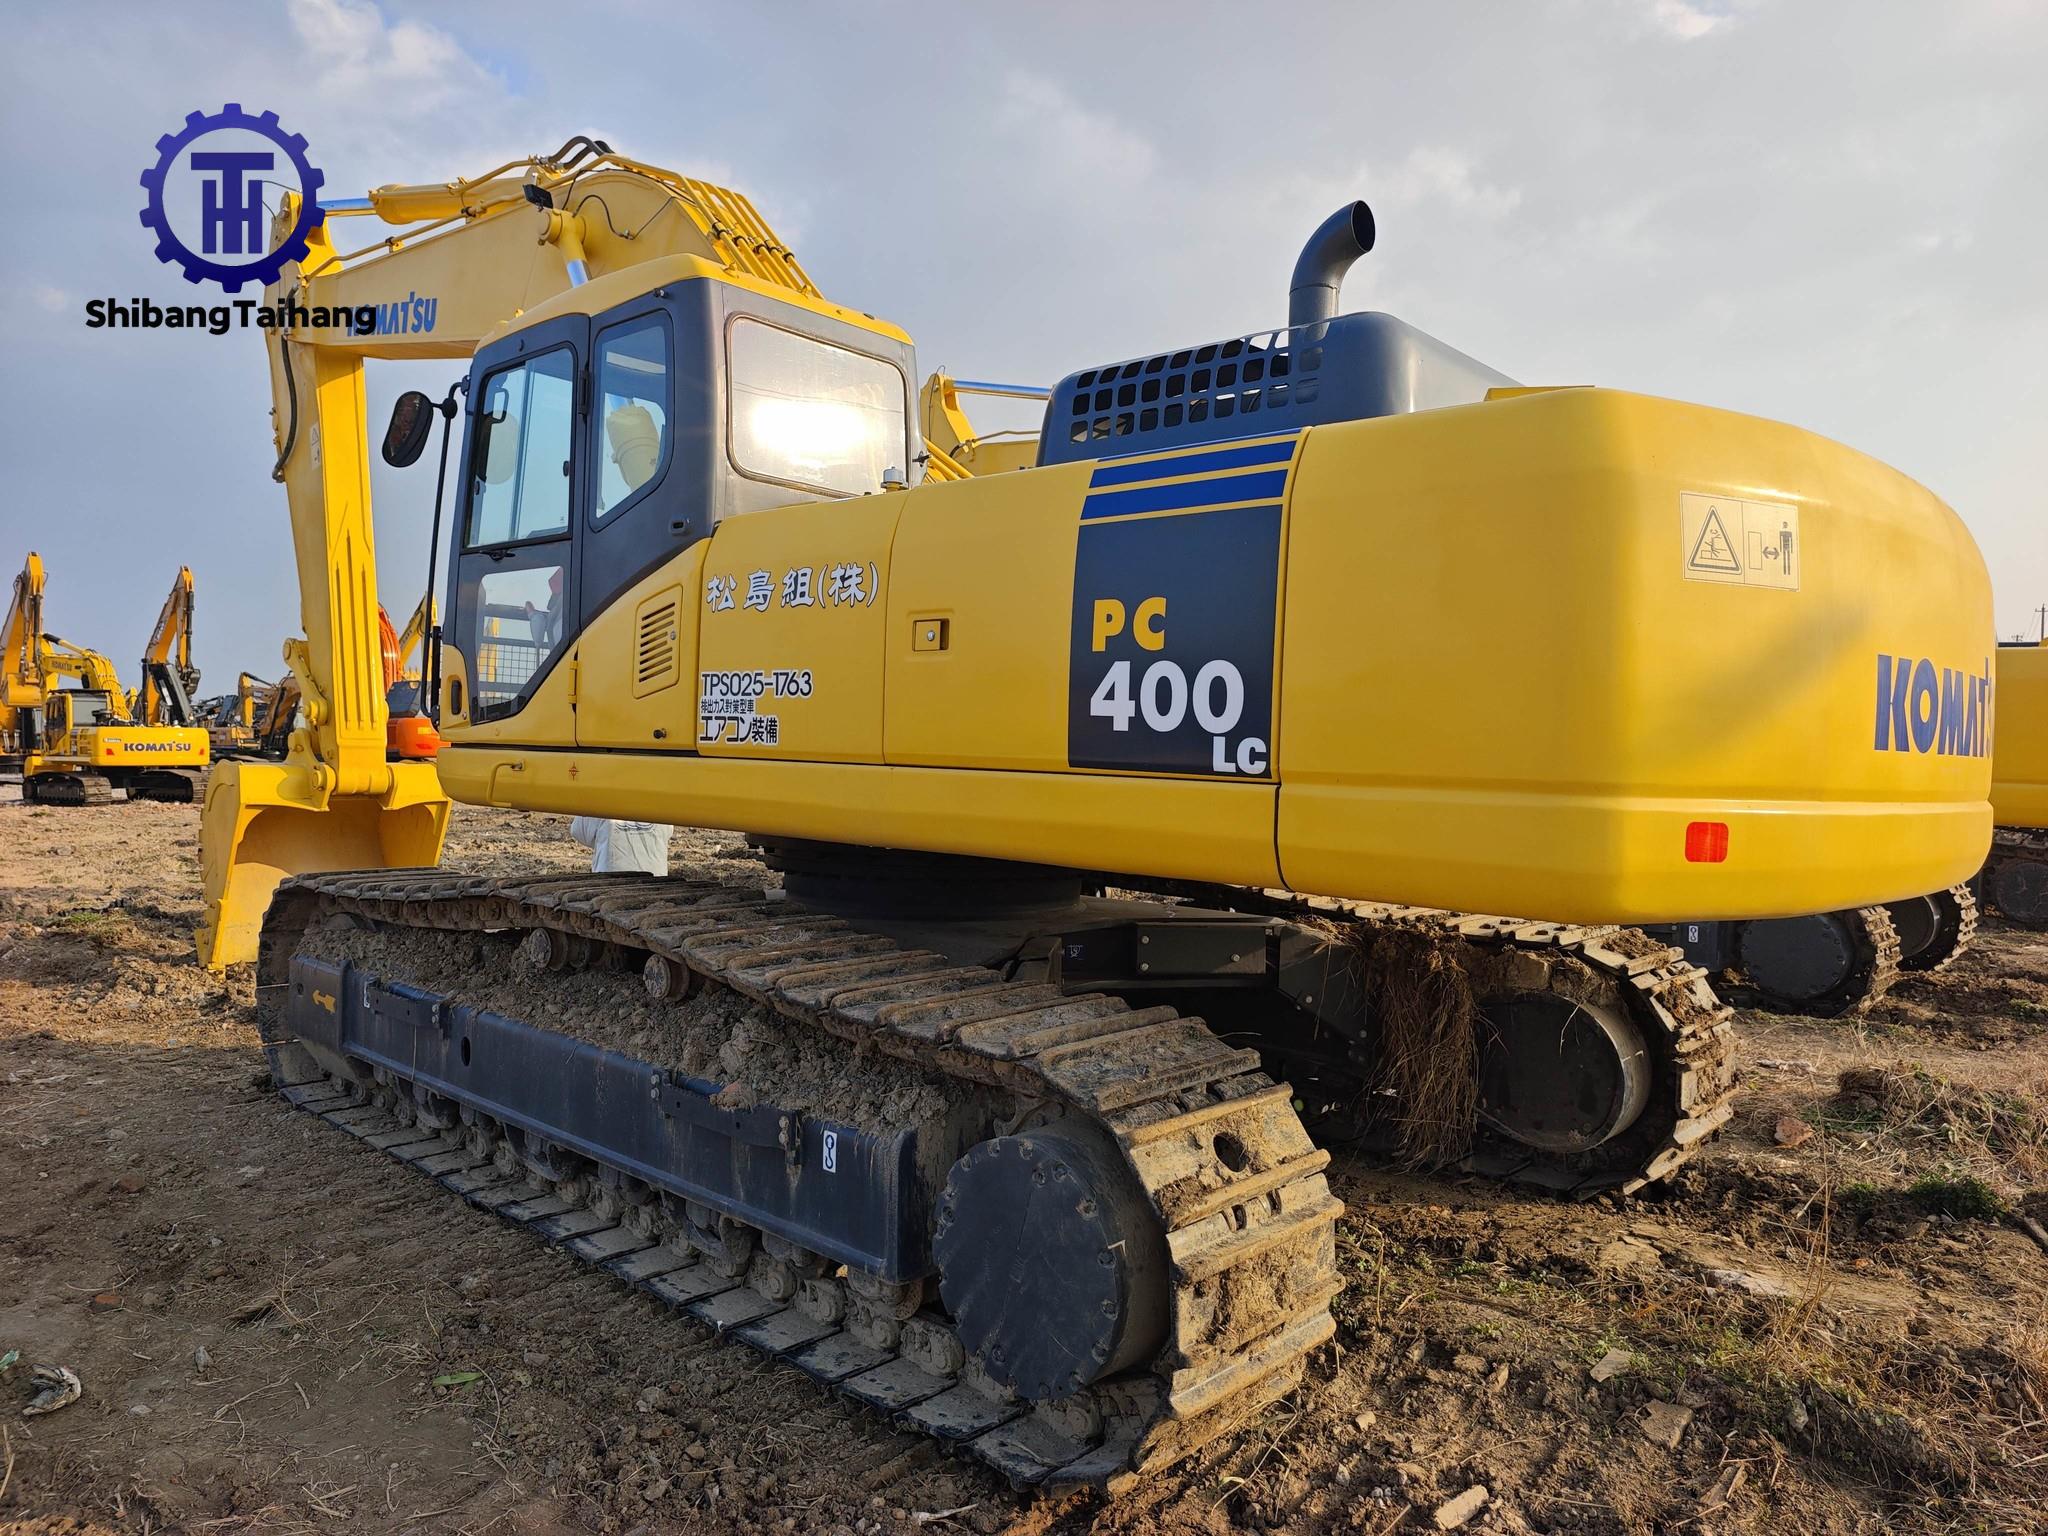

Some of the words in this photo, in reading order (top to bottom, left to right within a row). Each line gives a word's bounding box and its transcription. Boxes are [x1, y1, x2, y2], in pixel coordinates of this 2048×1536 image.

[1092, 596, 1167, 652] PC
[702, 671, 812, 697] TPS025-1763
[1090, 659, 1245, 734] 400
[1874, 654, 1992, 759] KOMAT
[124, 741, 191, 752] KOMATSU
[1212, 736, 1267, 775] LC
